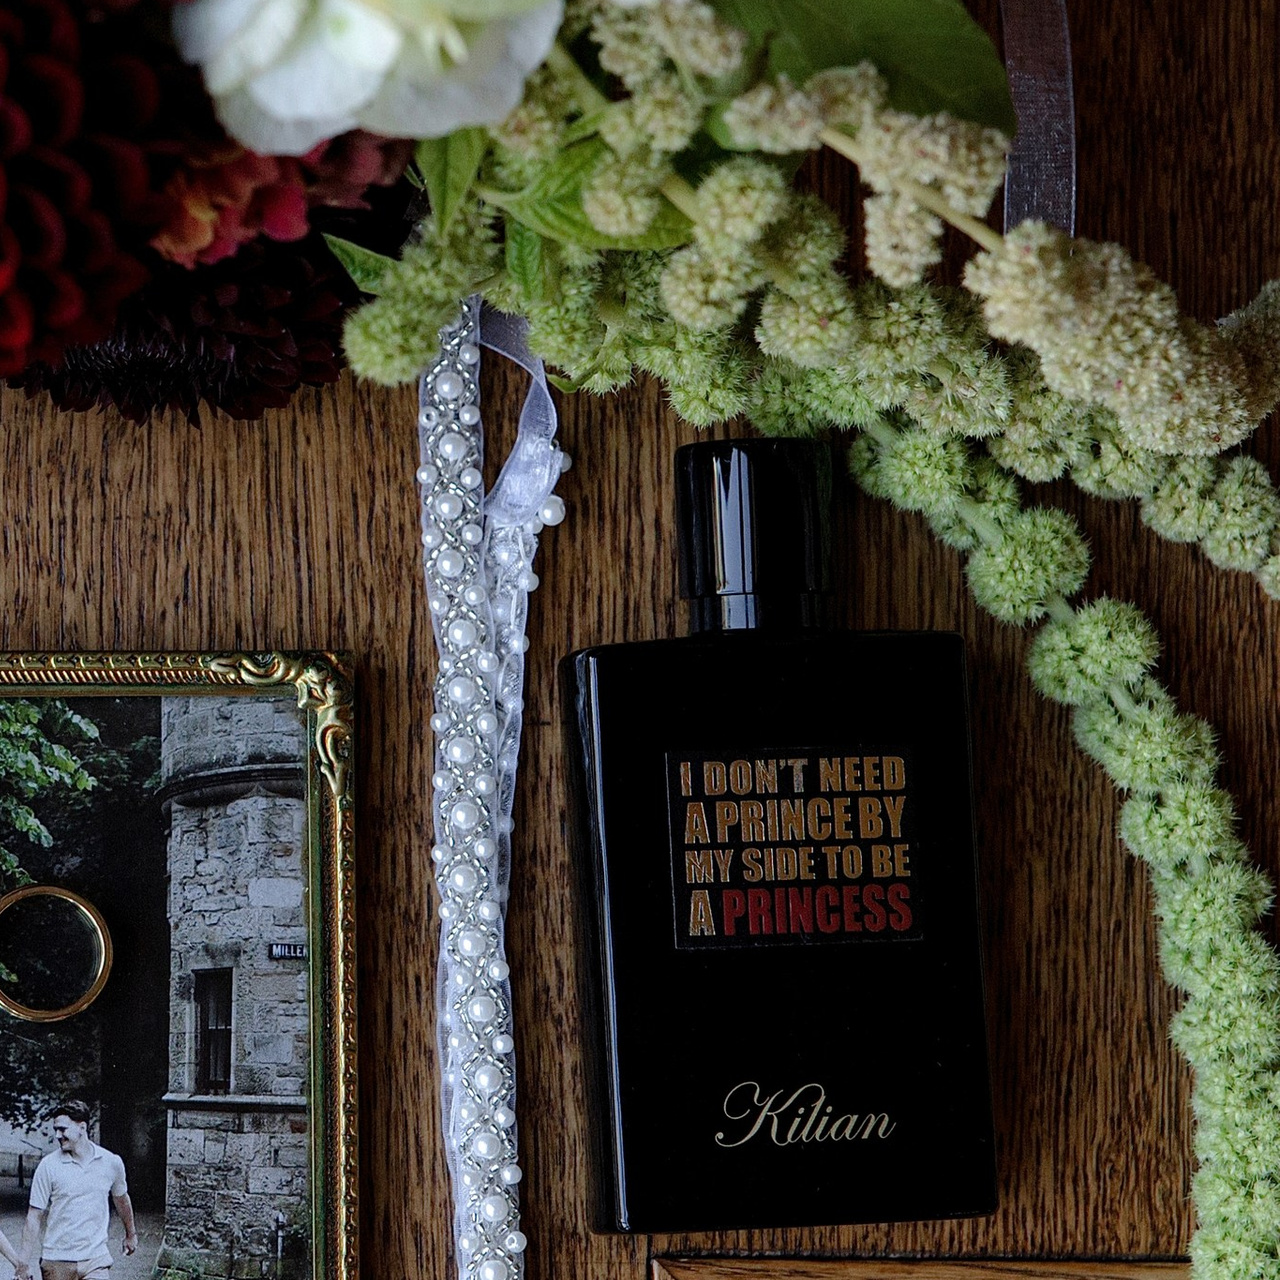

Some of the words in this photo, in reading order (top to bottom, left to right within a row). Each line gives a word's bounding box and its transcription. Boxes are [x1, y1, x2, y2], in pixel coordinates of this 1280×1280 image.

[679, 762, 692, 796] I
[703, 758, 808, 796] DON'T
[819, 756, 906, 792] NEED
[684, 801, 710, 844] A
[715, 797, 853, 843] PRINCE
[858, 795, 906, 839] BY
[685, 849, 734, 884] MY
[741, 846, 816, 883] SIDE
[822, 845, 863, 880] TO
[871, 844, 911, 878] BE
[689, 889, 716, 936] A
[722, 883, 913, 936] PRINCESS
[715, 1081, 897, 1148] Kilian
